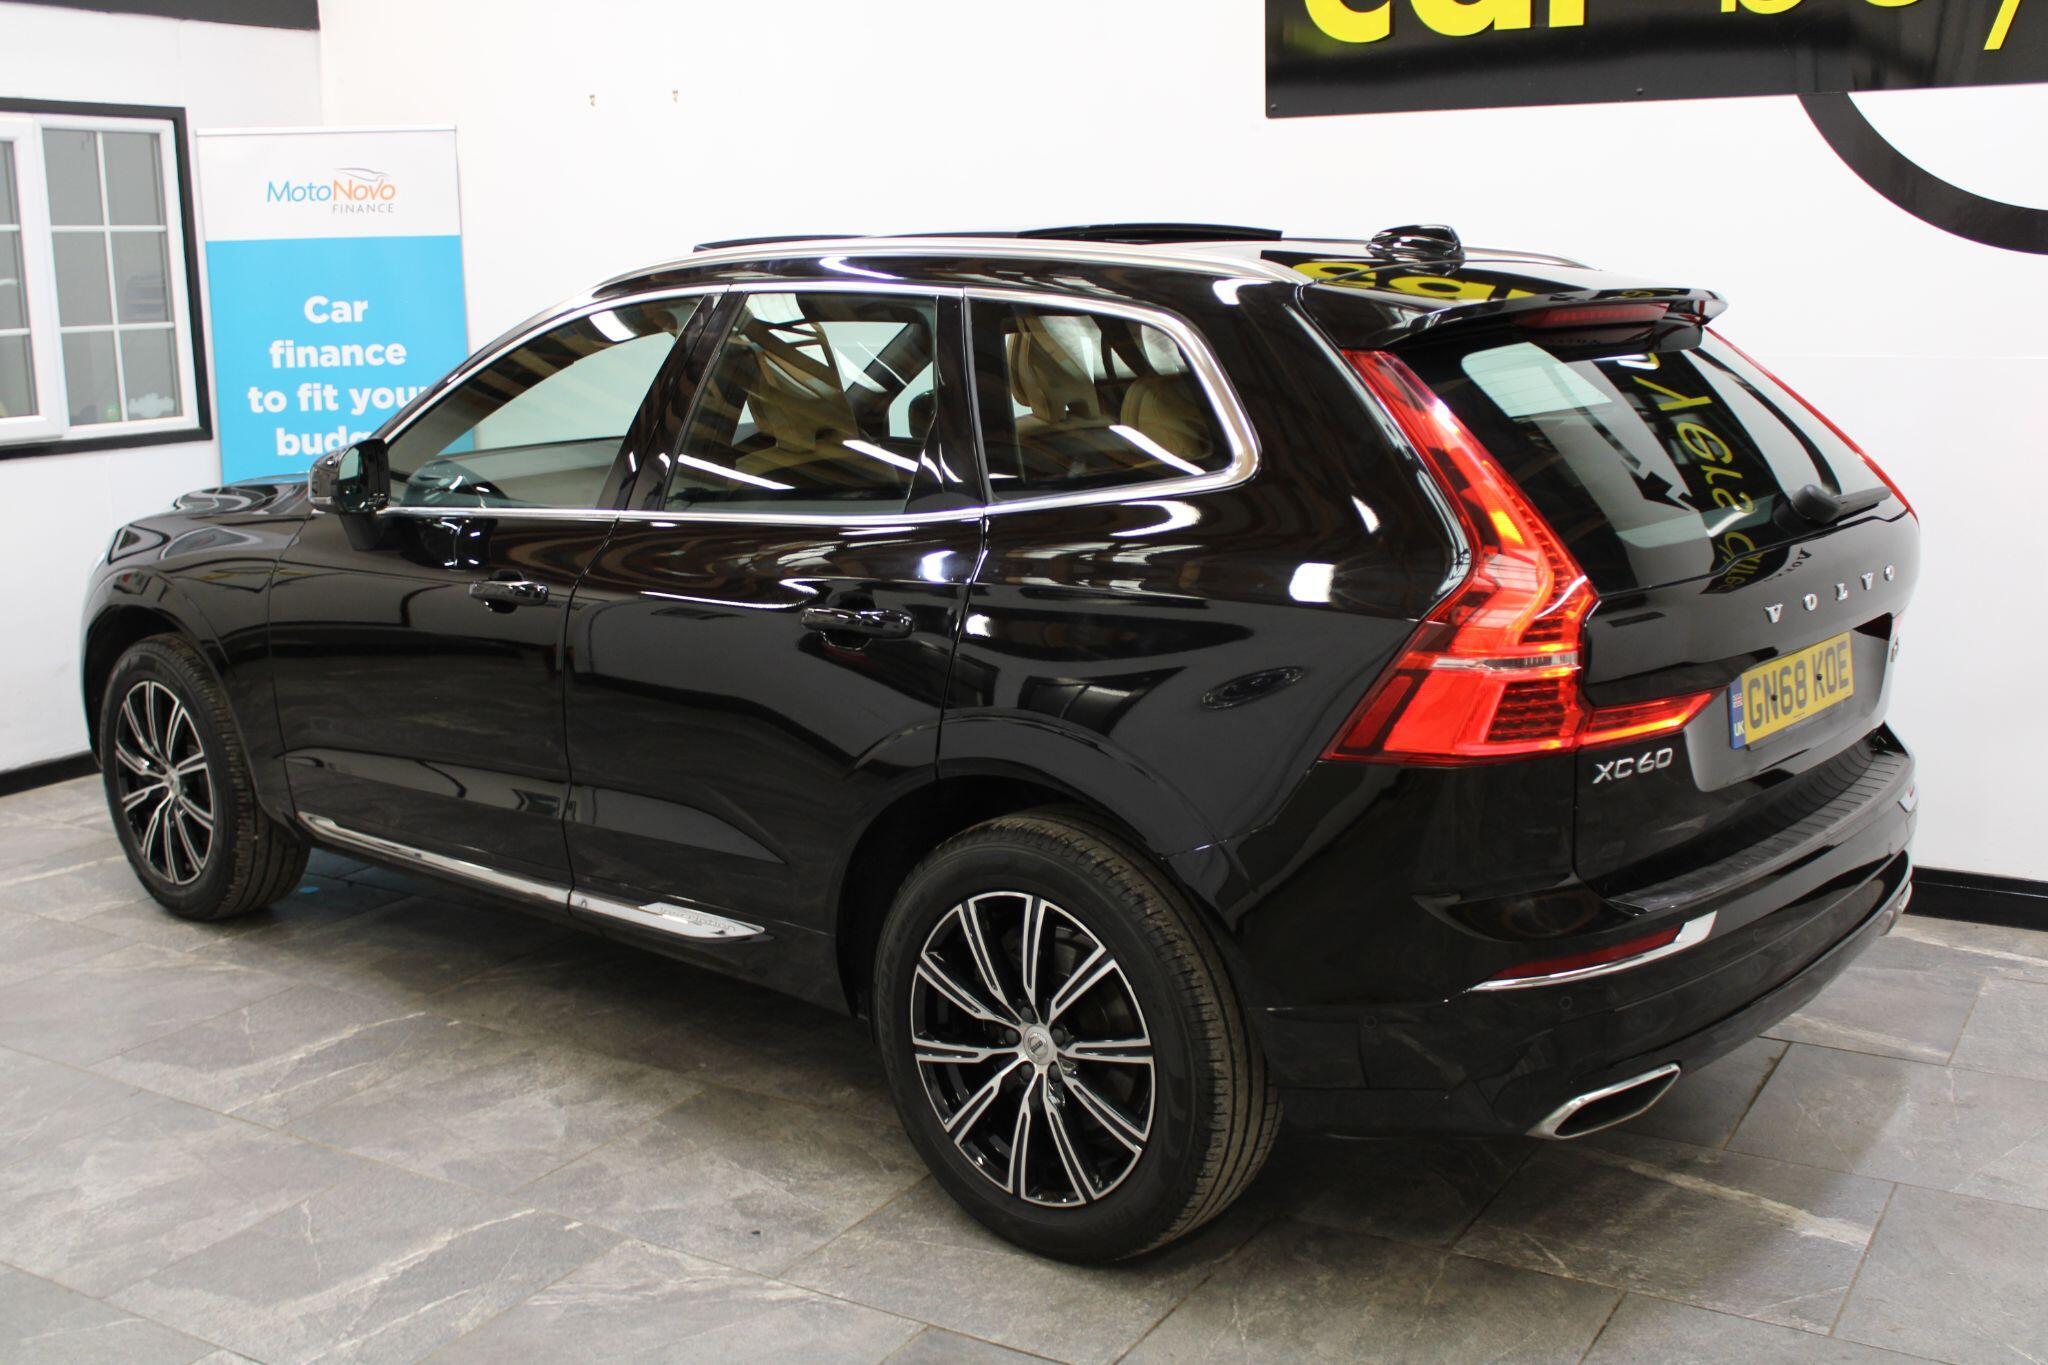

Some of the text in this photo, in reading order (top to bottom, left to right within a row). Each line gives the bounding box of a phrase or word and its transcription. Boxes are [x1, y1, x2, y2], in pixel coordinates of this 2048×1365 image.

[267, 179, 396, 202] MotoNovo
[332, 203, 395, 214] FINANCE
[304, 295, 368, 324] Car
[269, 339, 407, 369] finance
[248, 383, 427, 416] to fit you
[1764, 565, 1894, 624] VOLVO
[1748, 659, 1808, 729] GN68
[1812, 641, 1850, 701] KOE
[1734, 720, 1746, 737] UK
[1593, 747, 1673, 784] XC60
